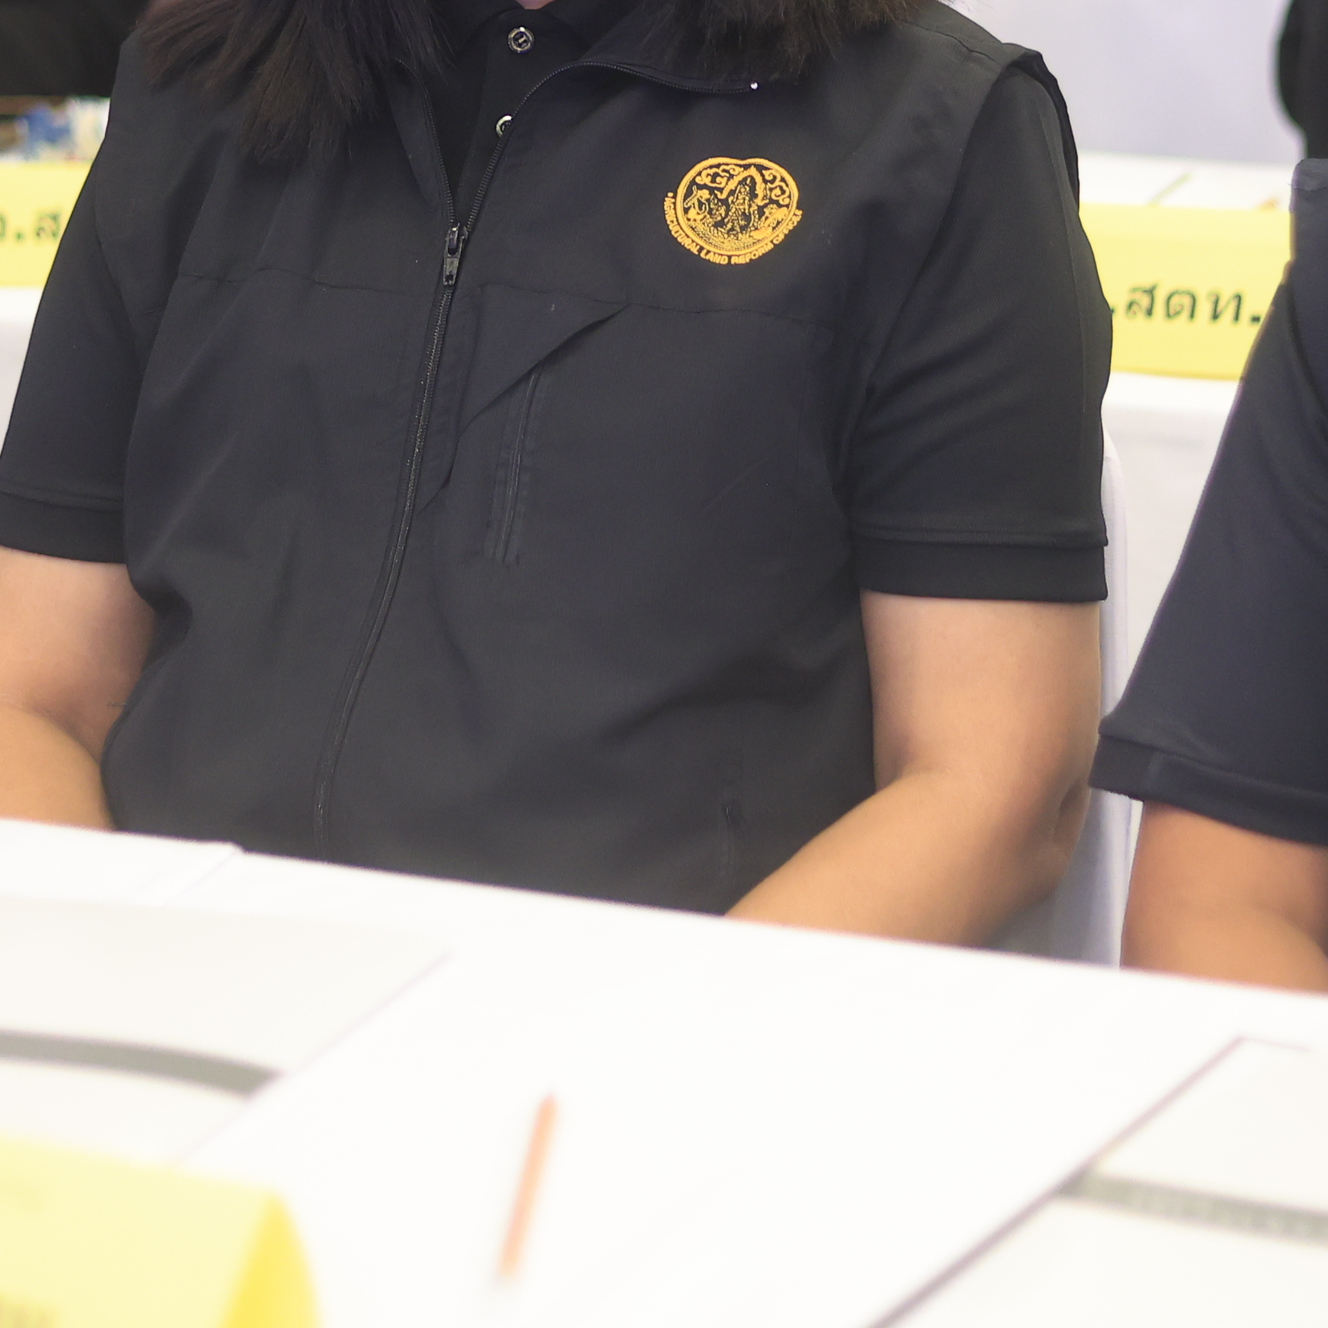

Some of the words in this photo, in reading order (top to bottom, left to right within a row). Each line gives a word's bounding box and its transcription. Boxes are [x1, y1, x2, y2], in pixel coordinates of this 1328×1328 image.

[663, 196, 701, 255] AGRICULTURAL
[700, 250, 729, 265] LAND
[730, 241, 775, 265] REFORM
[772, 208, 803, 245] OFFICE
